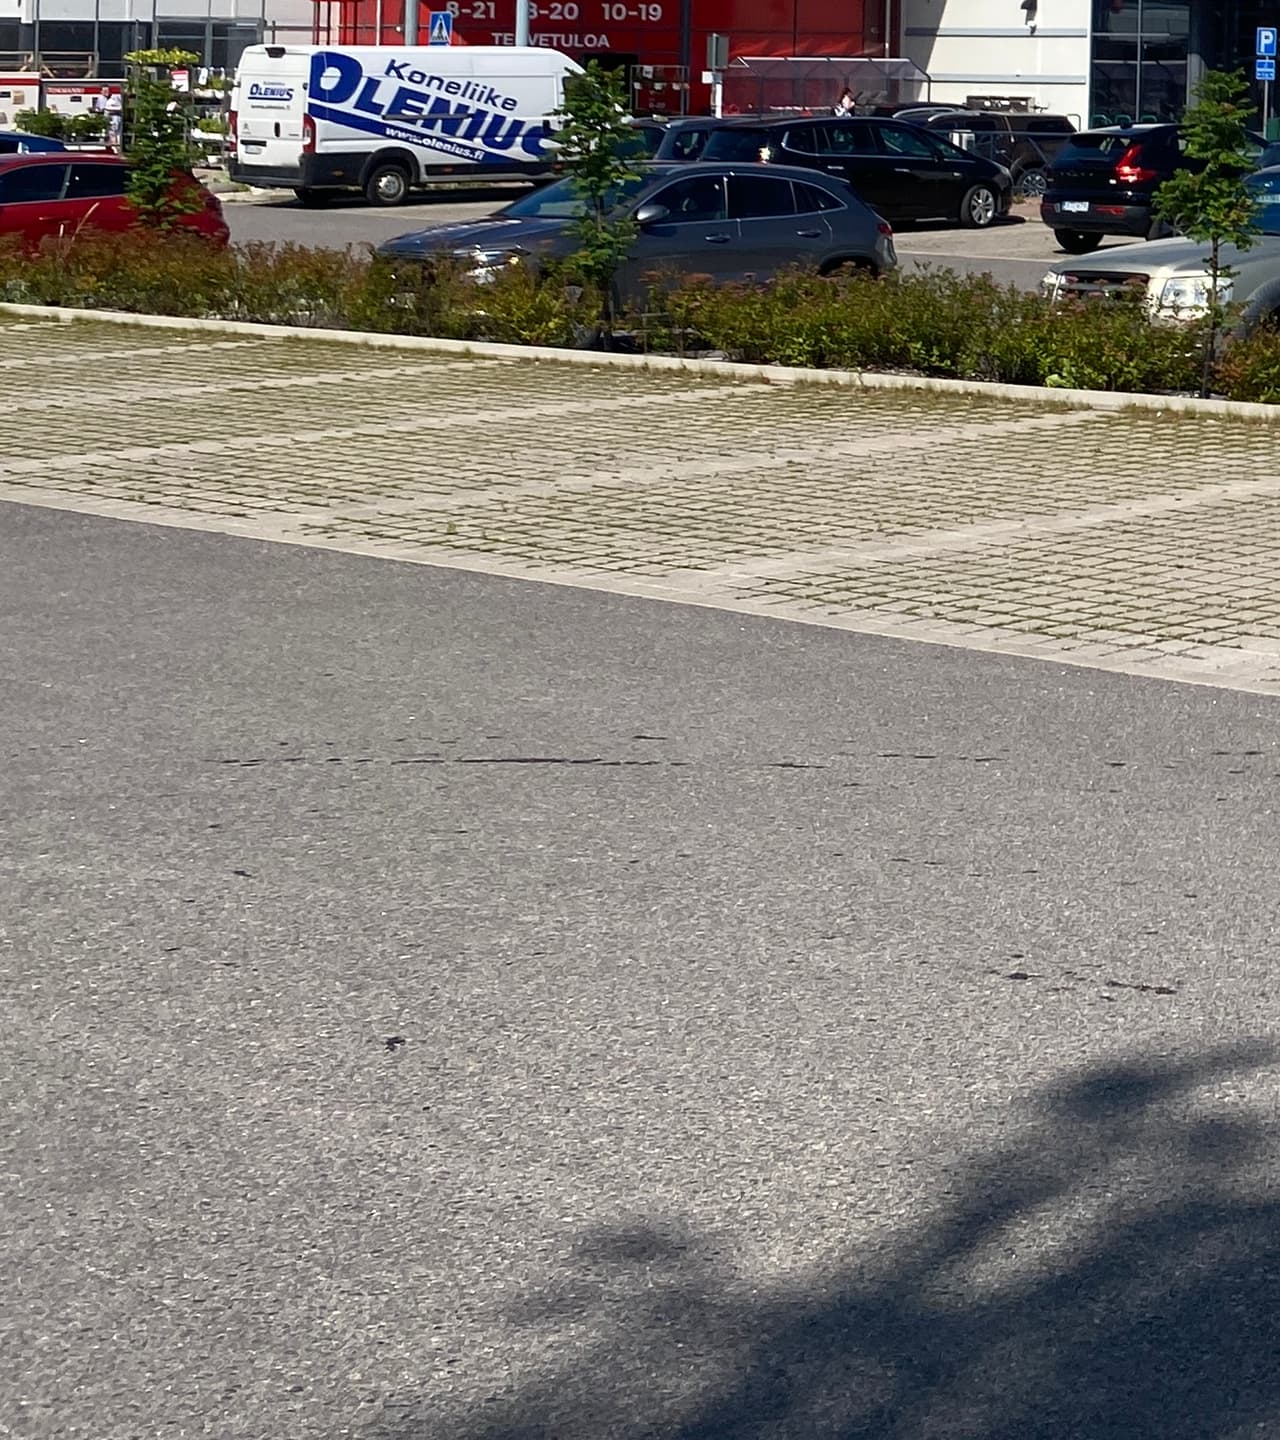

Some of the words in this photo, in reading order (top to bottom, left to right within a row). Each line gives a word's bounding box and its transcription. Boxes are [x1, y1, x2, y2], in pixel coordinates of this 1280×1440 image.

[446, 1, 496, 19] 8-21
[602, 3, 662, 21] 10-19
[492, 32, 610, 48] TEVETULOA
[1260, 30, 1273, 53] P
[385, 59, 517, 111] Koneliike
[385, 126, 485, 160] www.olenius.fi
